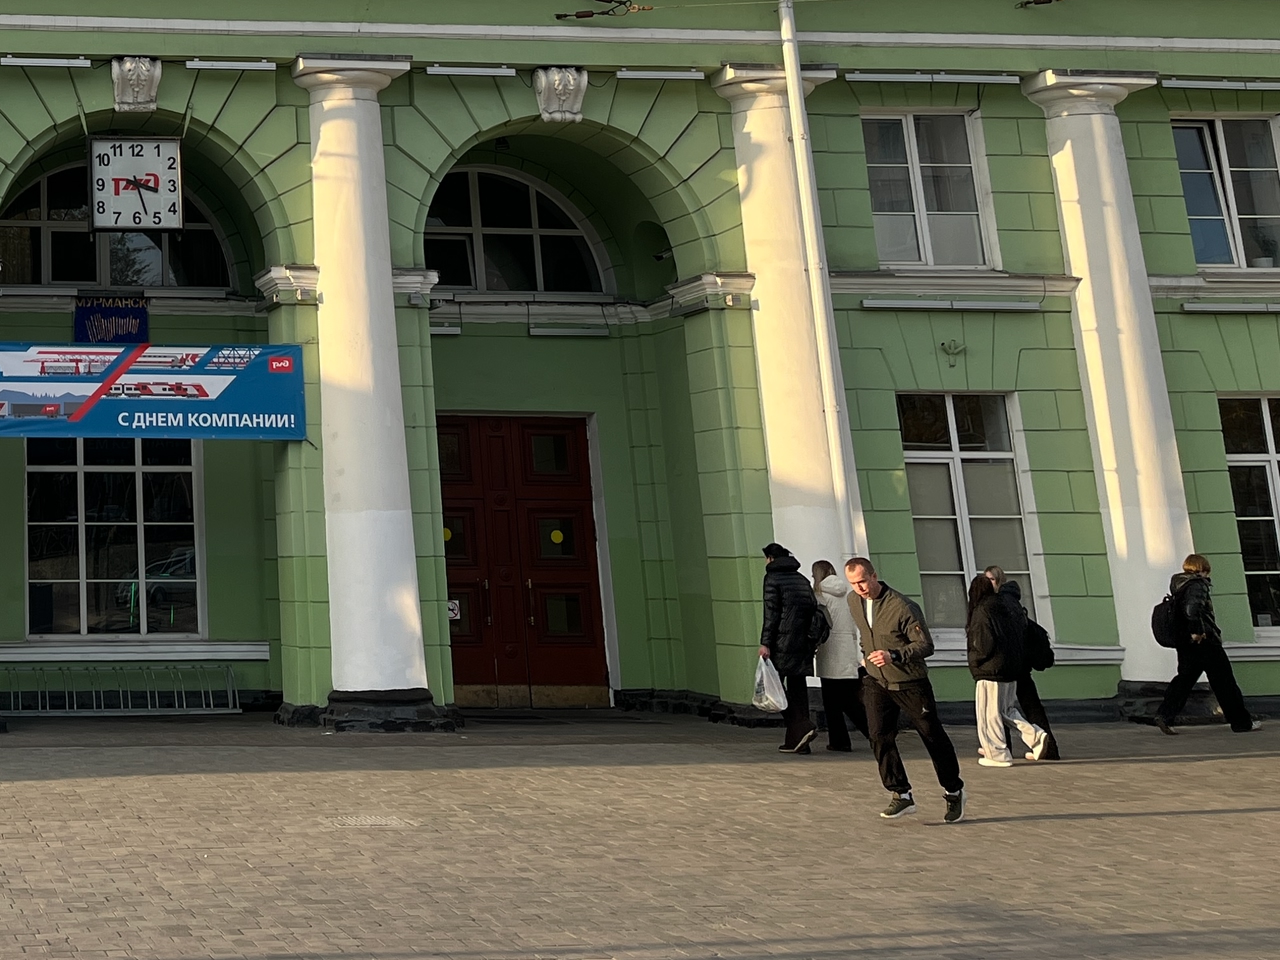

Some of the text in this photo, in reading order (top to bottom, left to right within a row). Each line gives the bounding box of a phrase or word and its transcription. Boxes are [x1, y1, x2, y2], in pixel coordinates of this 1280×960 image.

[110, 143, 160, 157] 11 12 1
[96, 153, 110, 166] 10
[167, 156, 176, 170] 2
[96, 178, 105, 191] 9
[168, 179, 177, 192] 3
[96, 201, 105, 214] 8
[168, 202, 177, 215] 4
[113, 211, 162, 225] 7 6 5
[75, 297, 148, 308] МУРМАНСК
[117, 412, 295, 429] С ДНЕМ КОМПАНИИ!
